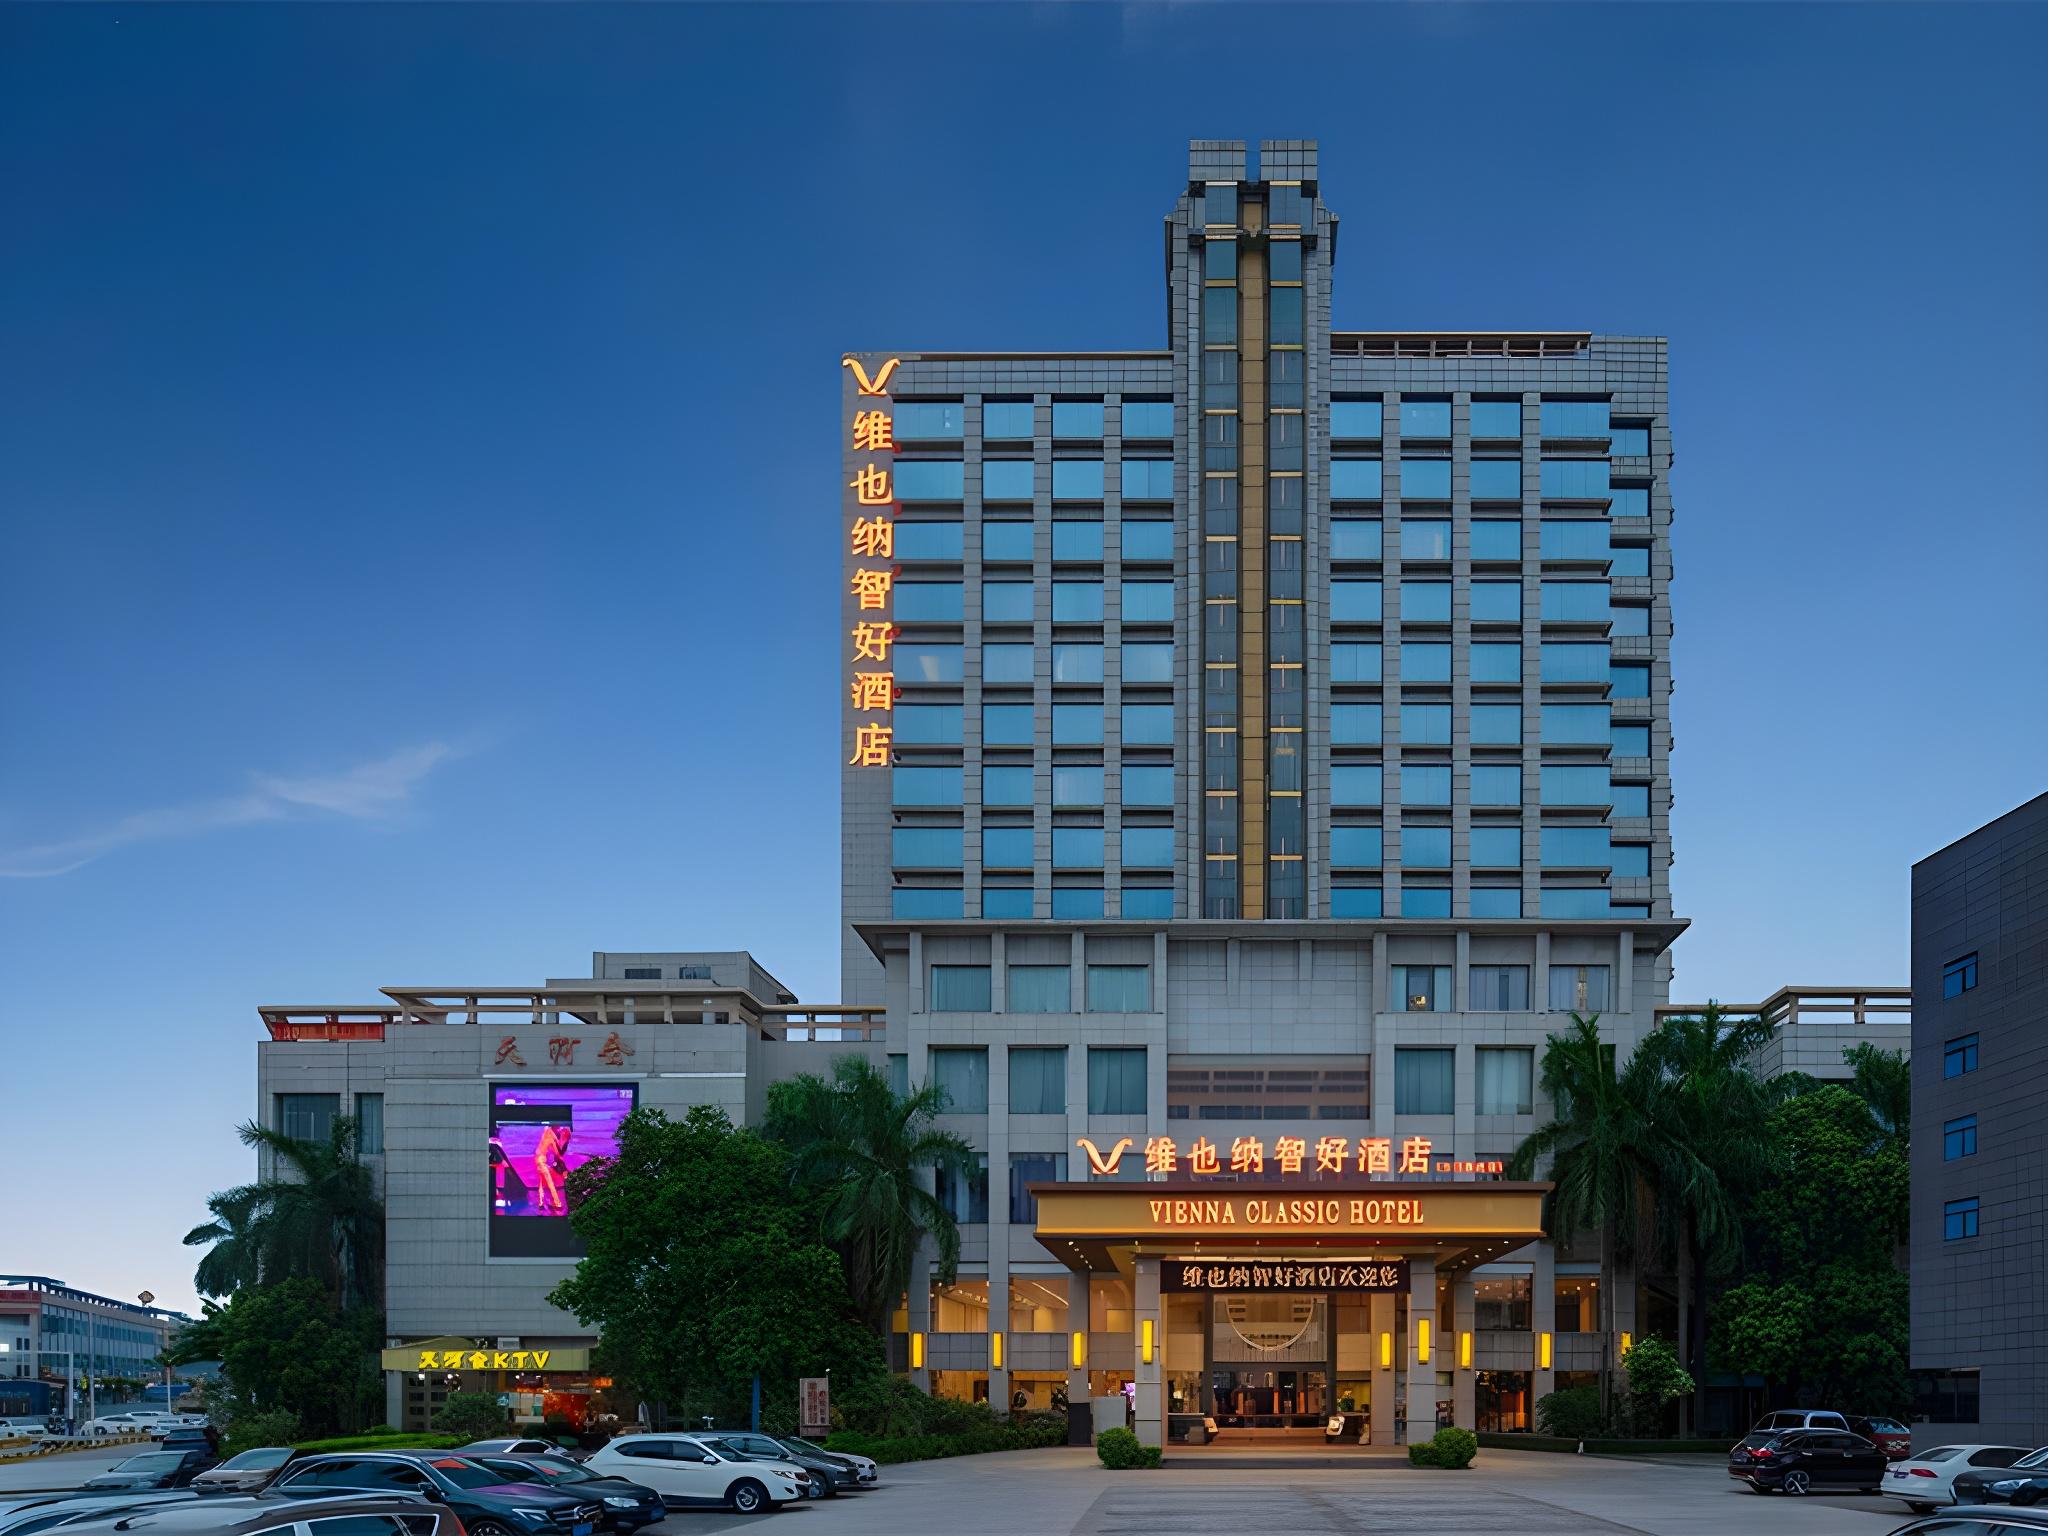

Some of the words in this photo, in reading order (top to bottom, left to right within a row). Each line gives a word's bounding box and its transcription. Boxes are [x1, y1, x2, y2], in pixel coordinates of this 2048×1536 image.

[850, 411, 893, 767] 维也纳智好酒店
[1145, 1136, 1432, 1174] 维也纳智好酒店
[1149, 1201, 1235, 1224] VIENNA
[1246, 1200, 1340, 1224] CLASSIC
[1350, 1200, 1424, 1224] HOTEL
